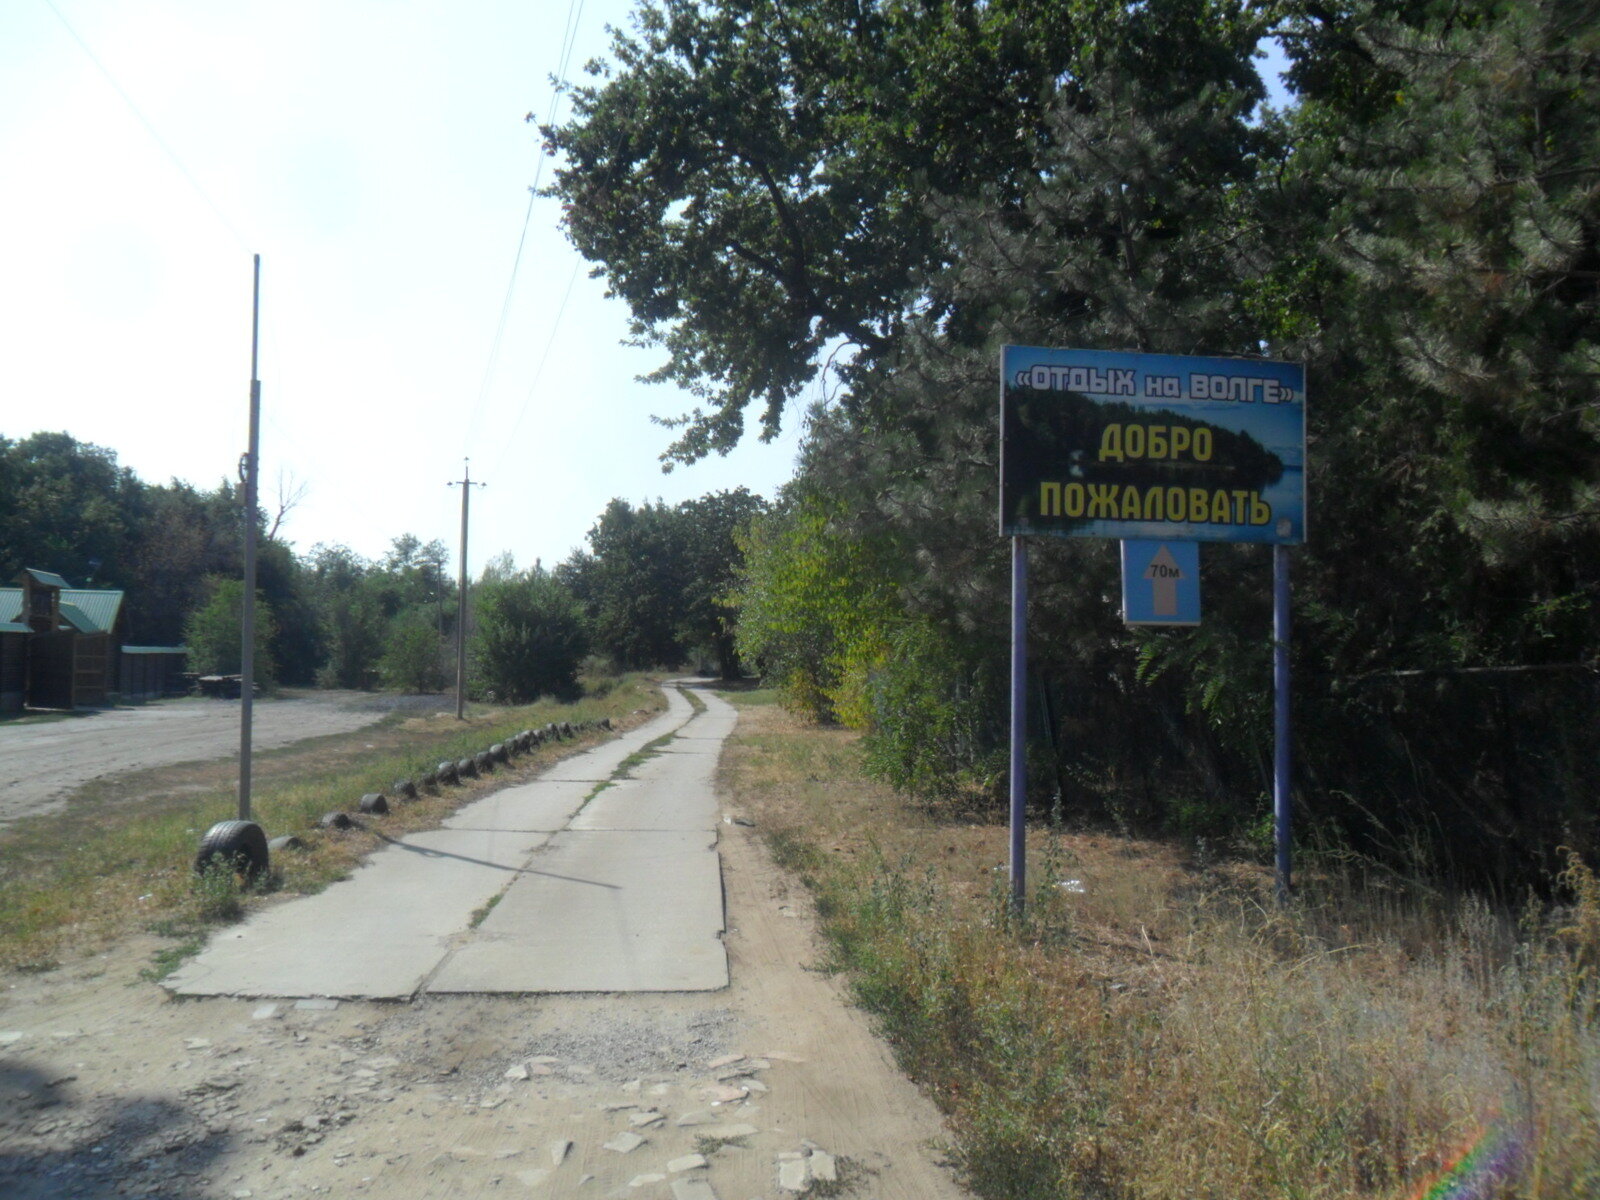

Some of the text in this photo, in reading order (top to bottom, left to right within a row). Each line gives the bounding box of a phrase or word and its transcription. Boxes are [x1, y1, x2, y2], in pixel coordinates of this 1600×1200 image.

[1015, 364, 1294, 404] «ОТДЫХ на ВОЛГЕ»
[1099, 423, 1213, 463] ДОБРО
[1040, 481, 1272, 526] ПОЖАЛОВАТЬ
